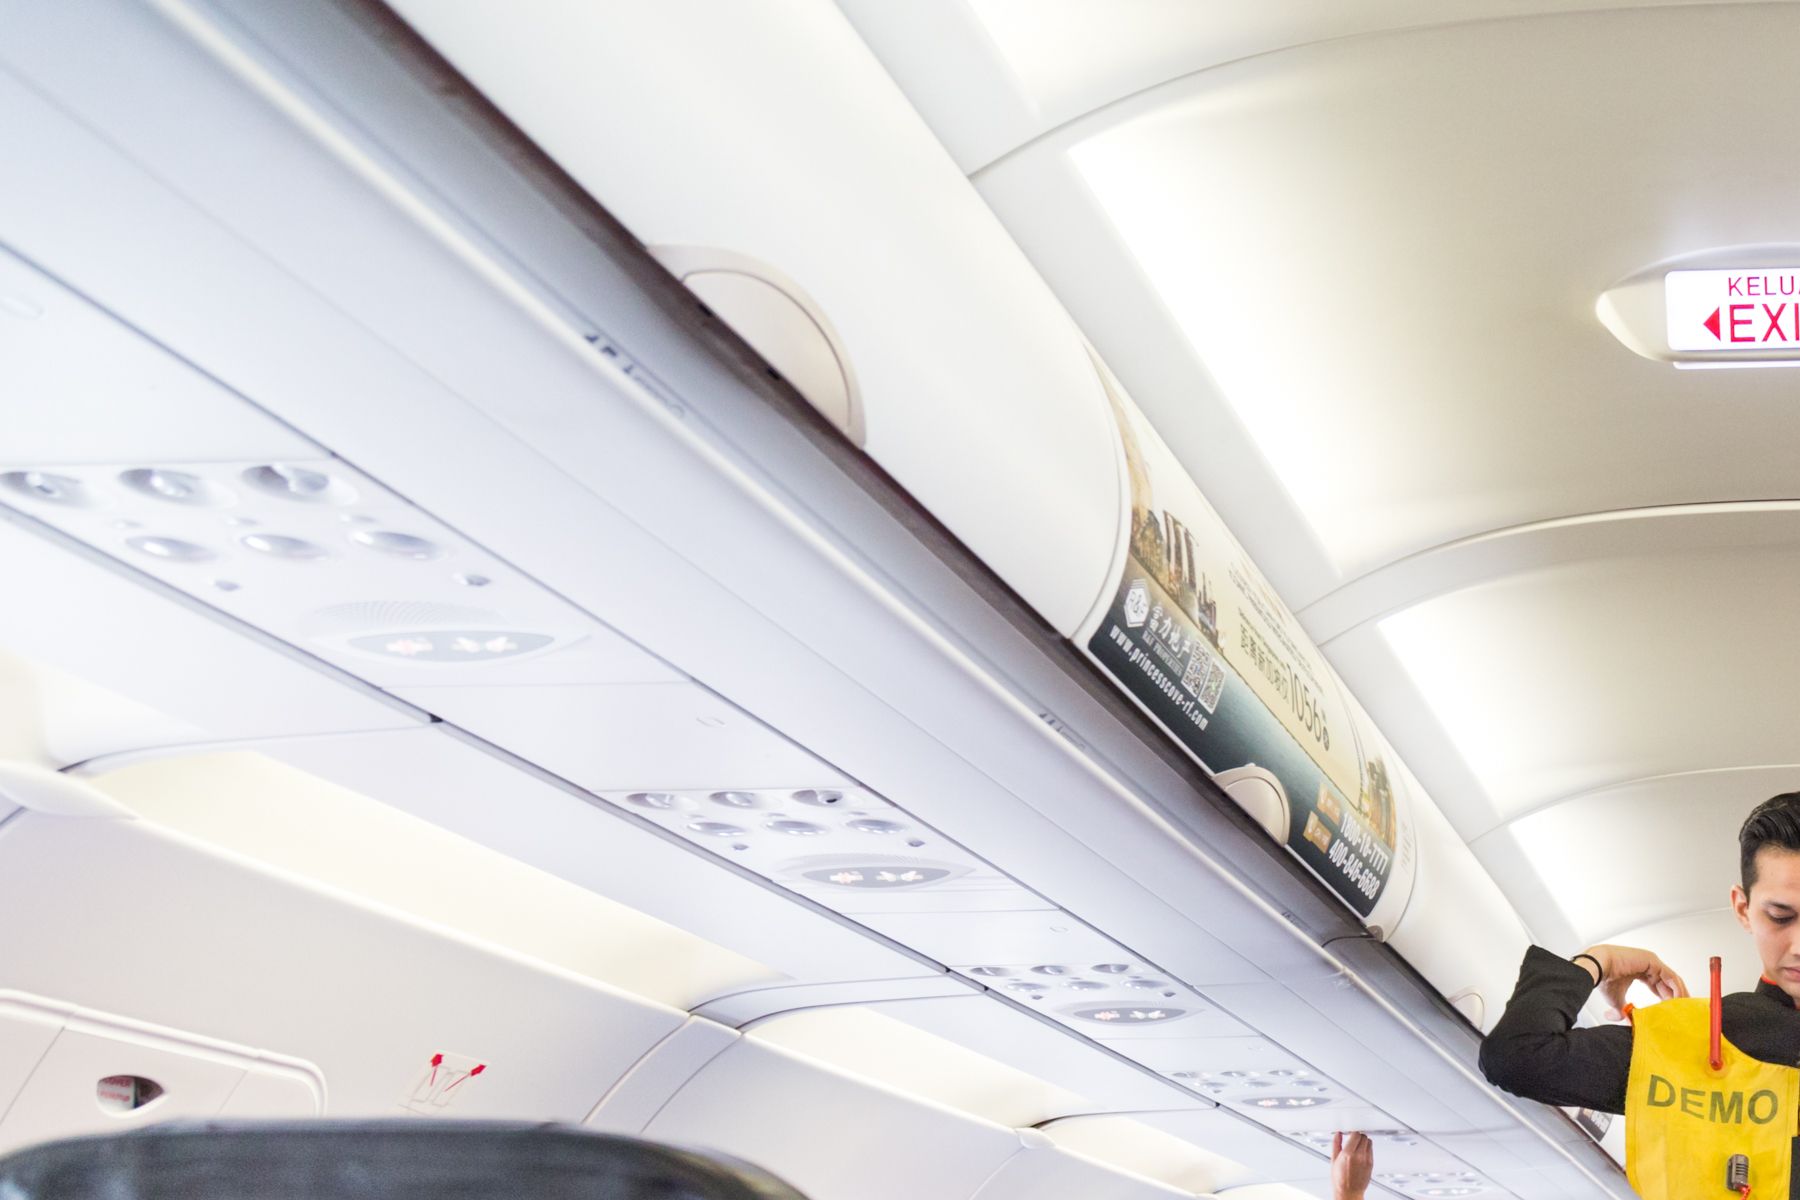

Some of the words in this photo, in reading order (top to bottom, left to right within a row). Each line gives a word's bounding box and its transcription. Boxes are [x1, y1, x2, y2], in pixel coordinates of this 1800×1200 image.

[1109, 625, 1209, 731] www.princesscove-rf.com
[1329, 838, 1381, 900] 400-846-6688
[1647, 1075, 1779, 1124] DEMO
